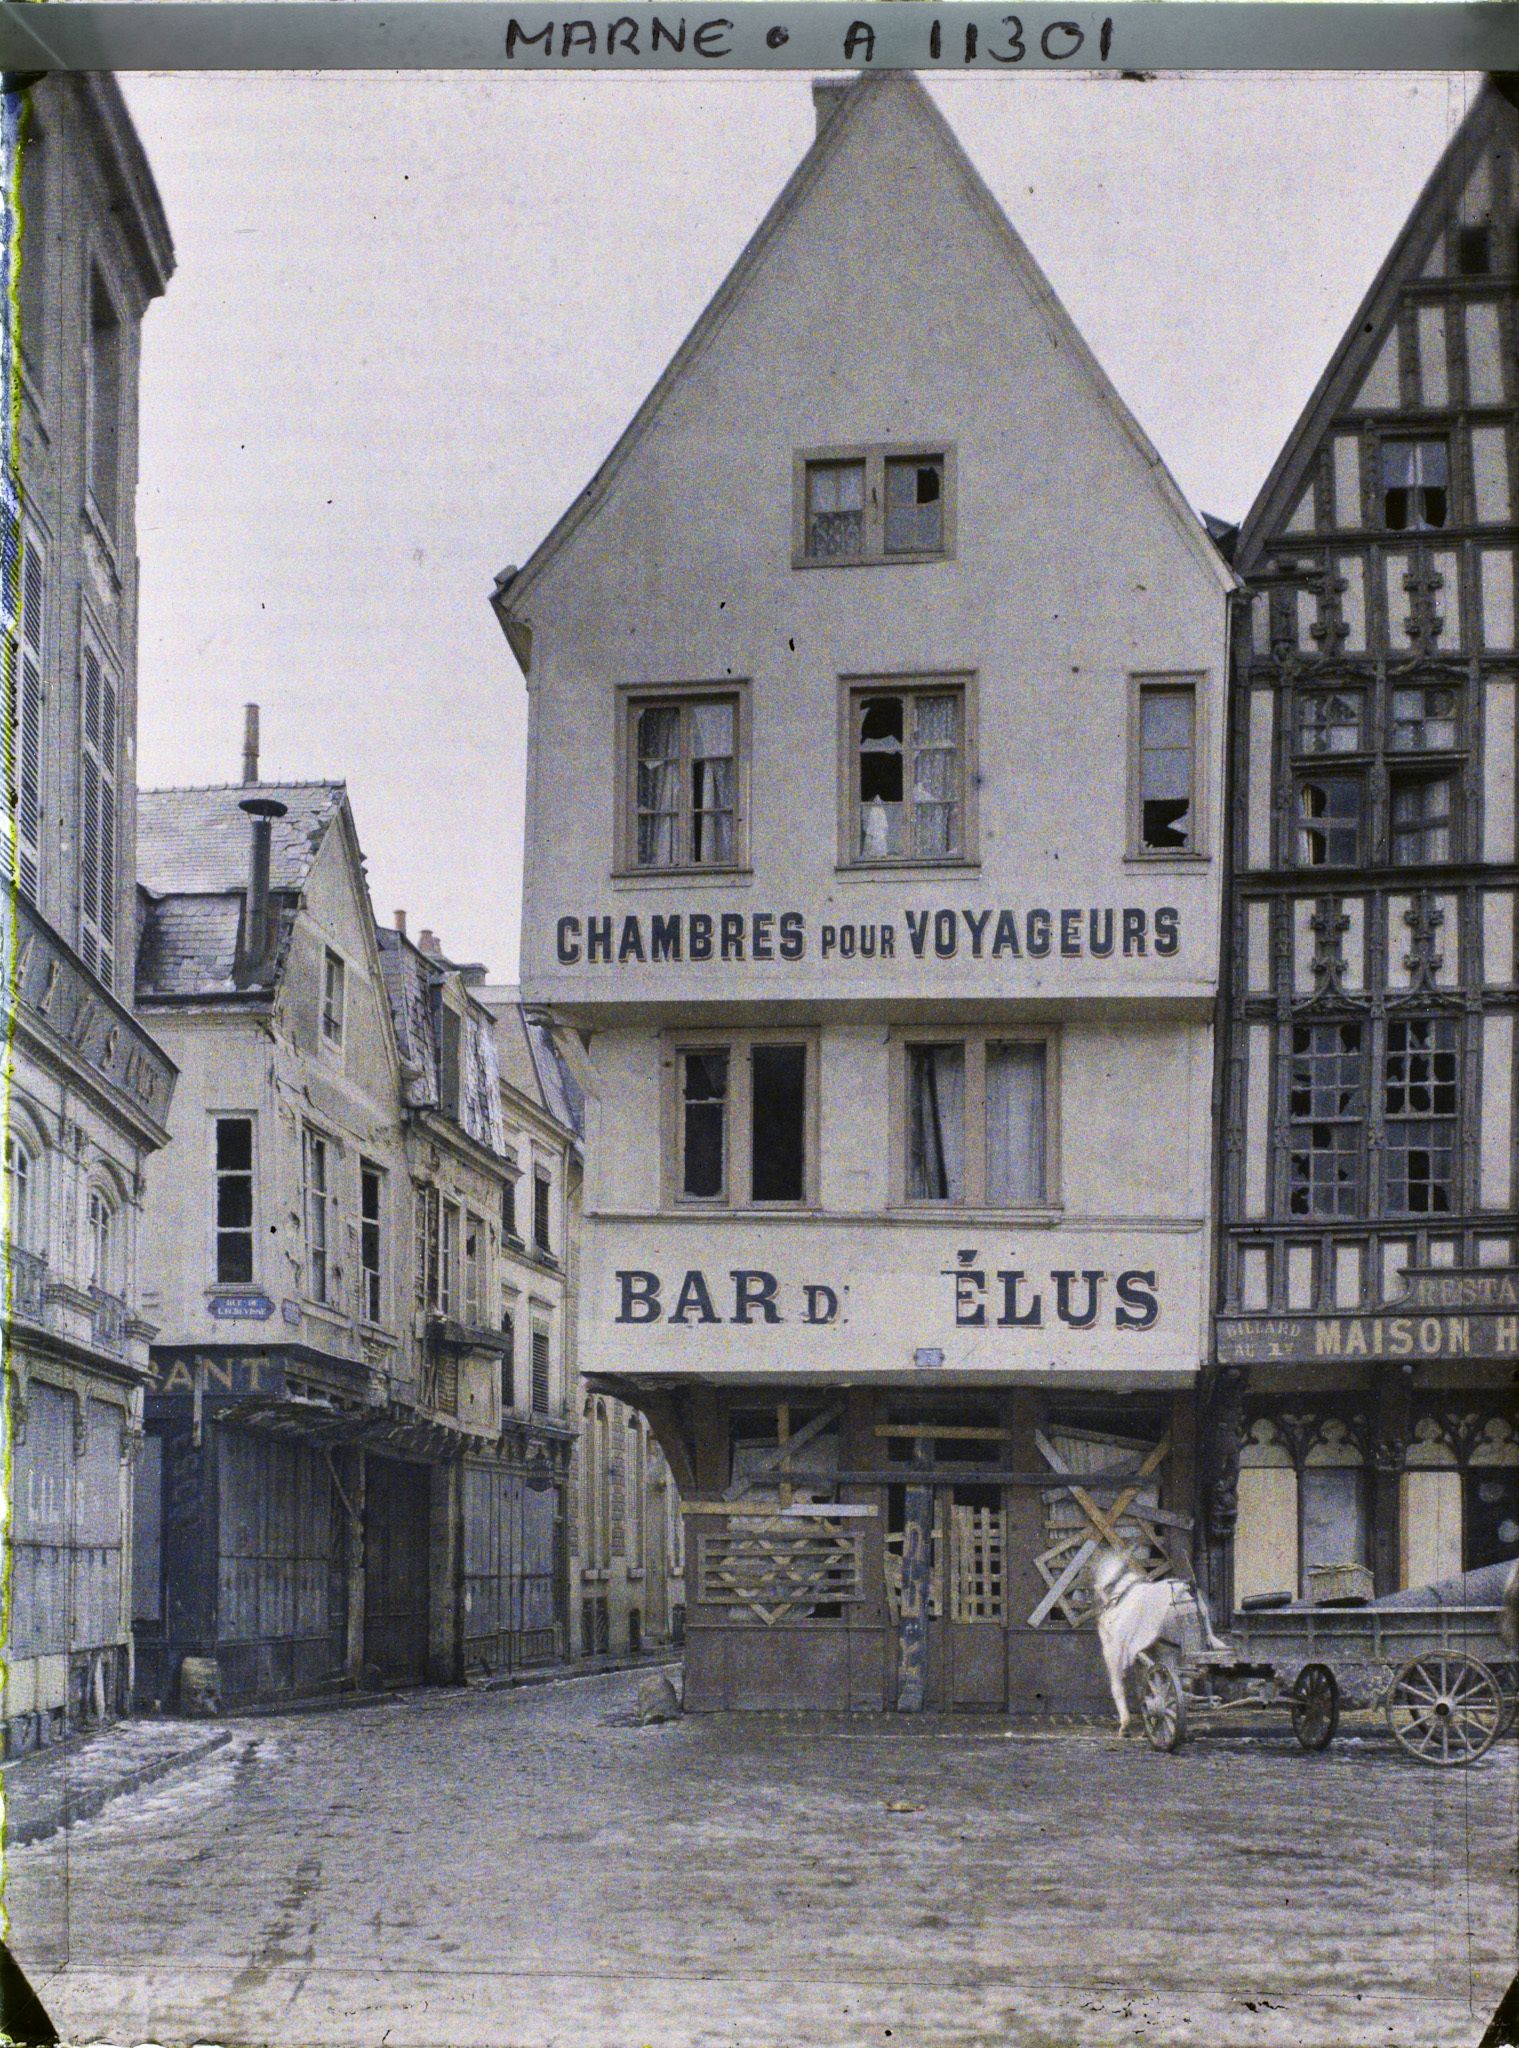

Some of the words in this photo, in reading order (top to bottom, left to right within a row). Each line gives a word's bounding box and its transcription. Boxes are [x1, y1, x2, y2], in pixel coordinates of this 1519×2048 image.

[557, 911, 805, 965] CHAMBRES
[821, 924, 895, 960] POUR
[905, 906, 1181, 960] VOYAGEURS
[615, 1270, 784, 1325] BAR
[1226, 1319, 1302, 1338] BILLARD
[1315, 1315, 1471, 1356] MAISON
